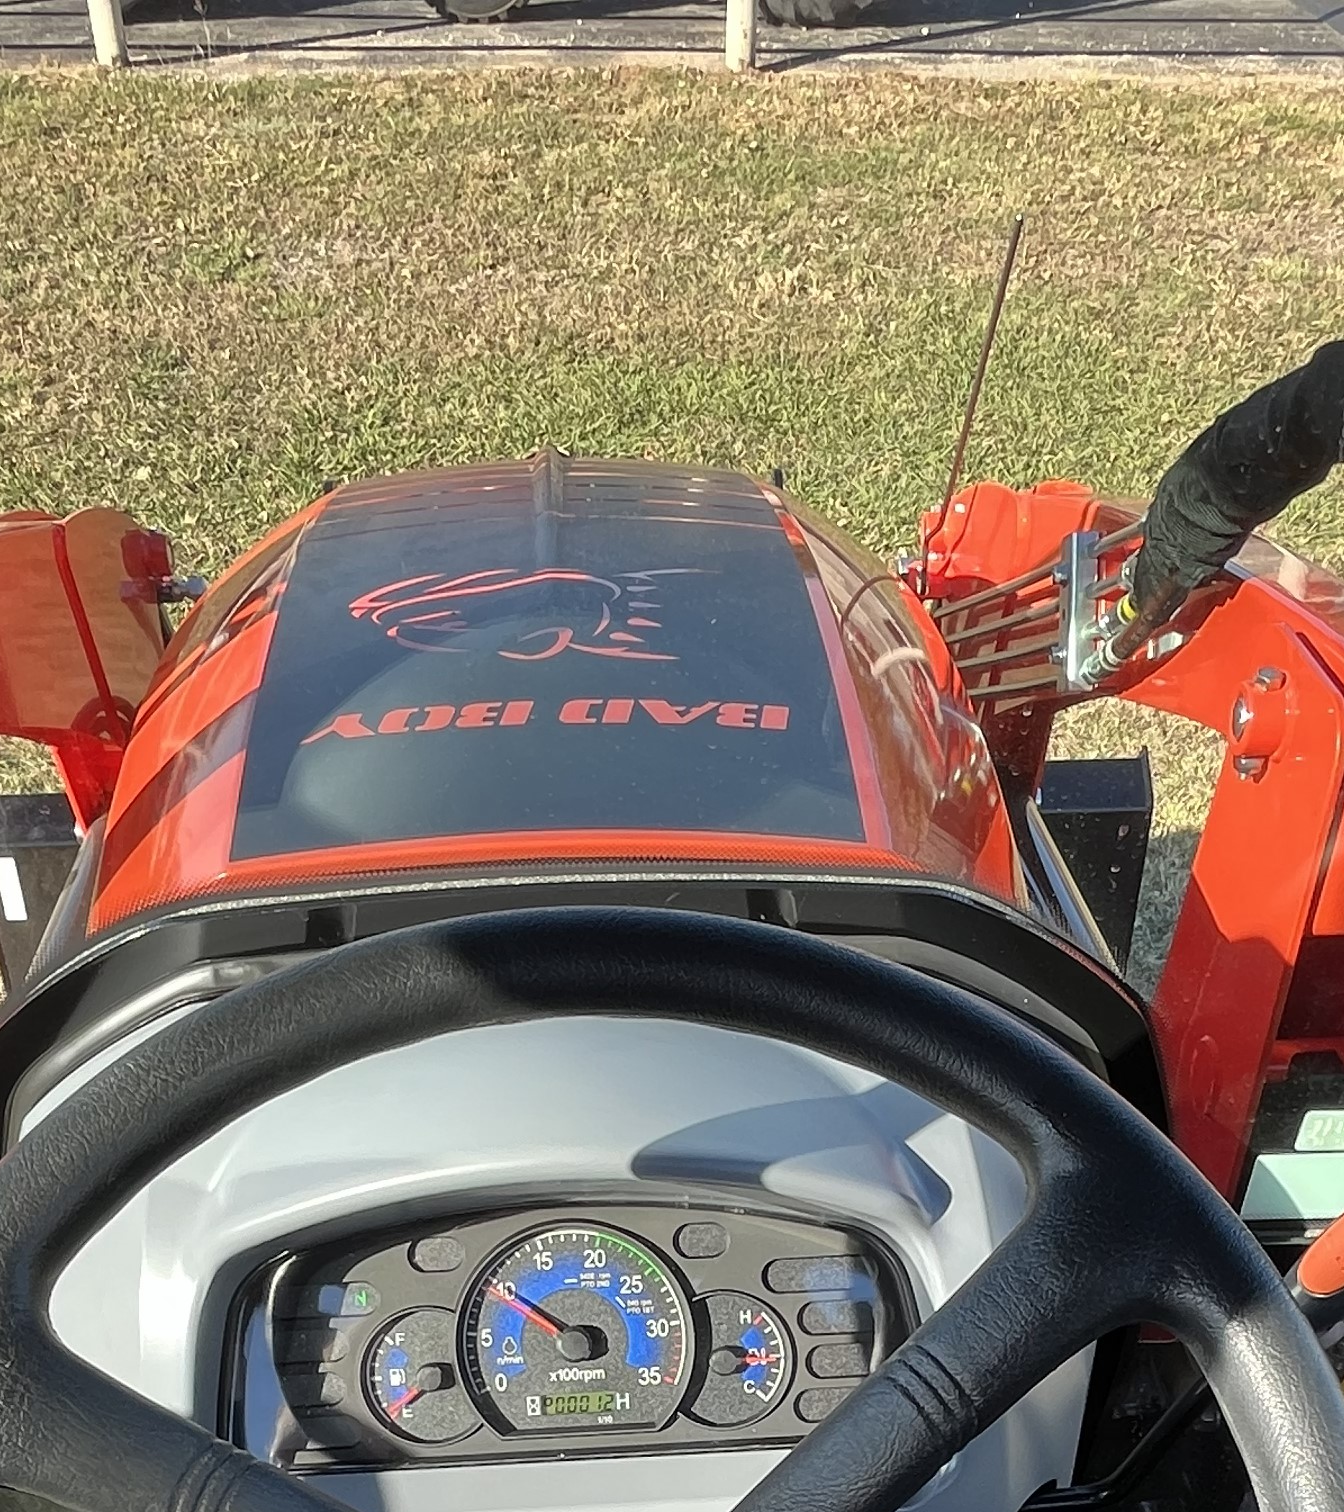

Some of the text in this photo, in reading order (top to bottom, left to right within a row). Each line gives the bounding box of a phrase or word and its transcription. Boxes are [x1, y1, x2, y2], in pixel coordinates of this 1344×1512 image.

[301, 697, 791, 745] BAD BOY
[532, 1251, 554, 1271] 15
[583, 1249, 606, 1268] 20
[619, 1275, 643, 1294] 25
[354, 1290, 366, 1306] N
[739, 1309, 752, 1324] H
[646, 1318, 670, 1337] 30
[395, 1332, 406, 1346] F
[481, 1328, 493, 1347] 5
[494, 1373, 508, 1392] 0
[548, 1367, 606, 1383] x100rpm
[637, 1366, 662, 1386] 35
[743, 1379, 756, 1394] C
[616, 1393, 631, 1410] H
[402, 1406, 414, 1418] E
